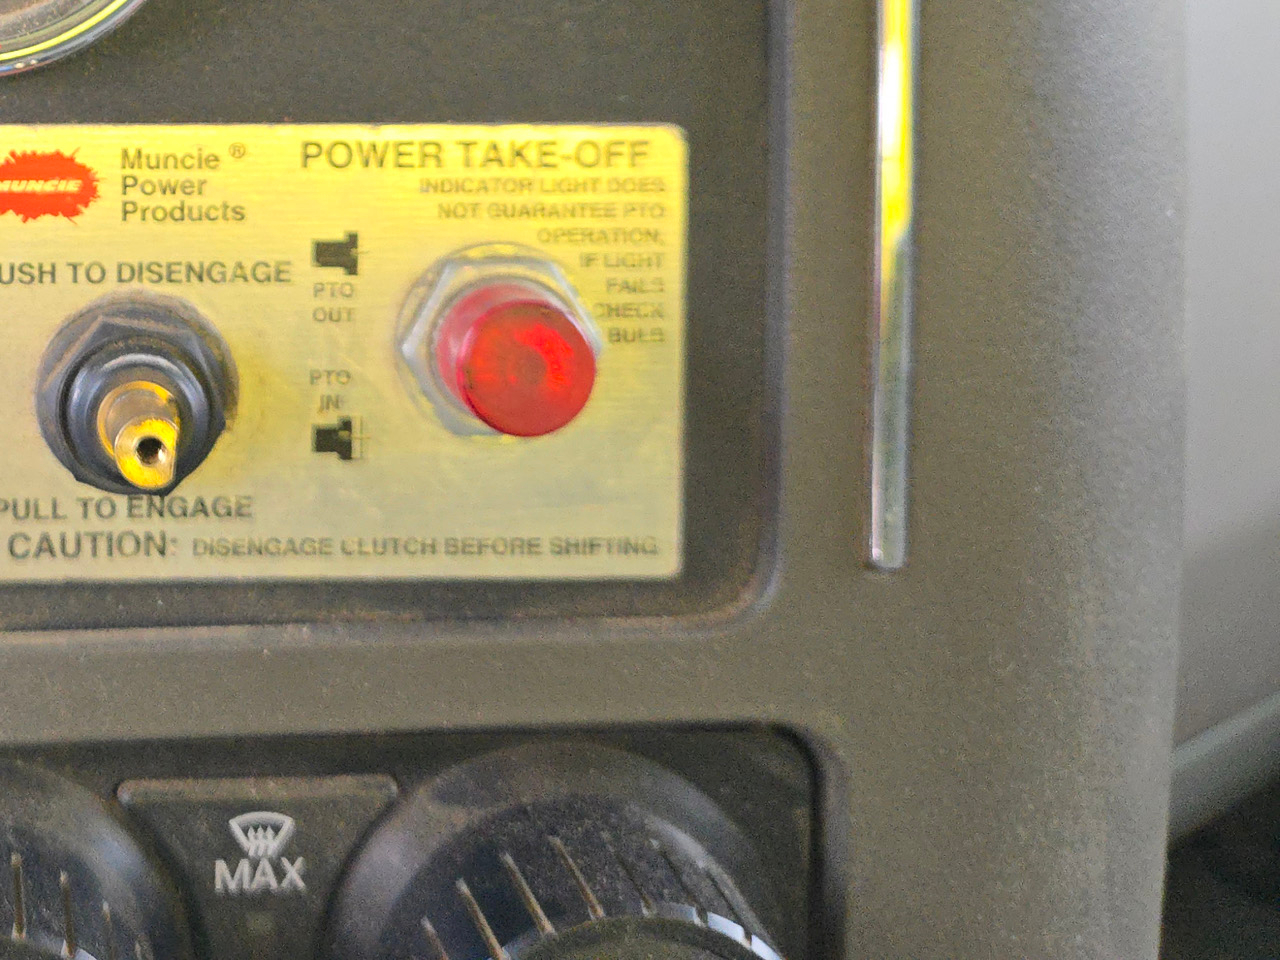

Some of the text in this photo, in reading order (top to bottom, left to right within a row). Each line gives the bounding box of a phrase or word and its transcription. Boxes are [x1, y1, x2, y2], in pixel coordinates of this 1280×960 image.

[121, 148, 220, 170] Muncie
[300, 140, 651, 170] POWER TAKE-OFF
[121, 175, 208, 196] Power
[420, 177, 665, 194] INDICATOR LIGHT DOES
[121, 201, 246, 222] Products
[438, 202, 666, 219] NOT GUARANTEE PTO
[579, 252, 664, 268] IF LIGHT
[67, 261, 107, 284] TO
[117, 260, 293, 284] DISENGAGE
[313, 282, 354, 299] PTO
[606, 277, 665, 294] FAILS
[312, 307, 354, 323] OUT
[310, 370, 353, 387] PTO
[319, 393, 344, 412] IN
[79, 496, 116, 520] TO
[126, 495, 253, 519] ENGAGE
[7, 532, 659, 559] CAUTION: DISENGAGE CLUTCH BEFORE SHIFTING
[214, 856, 306, 893] MAX
